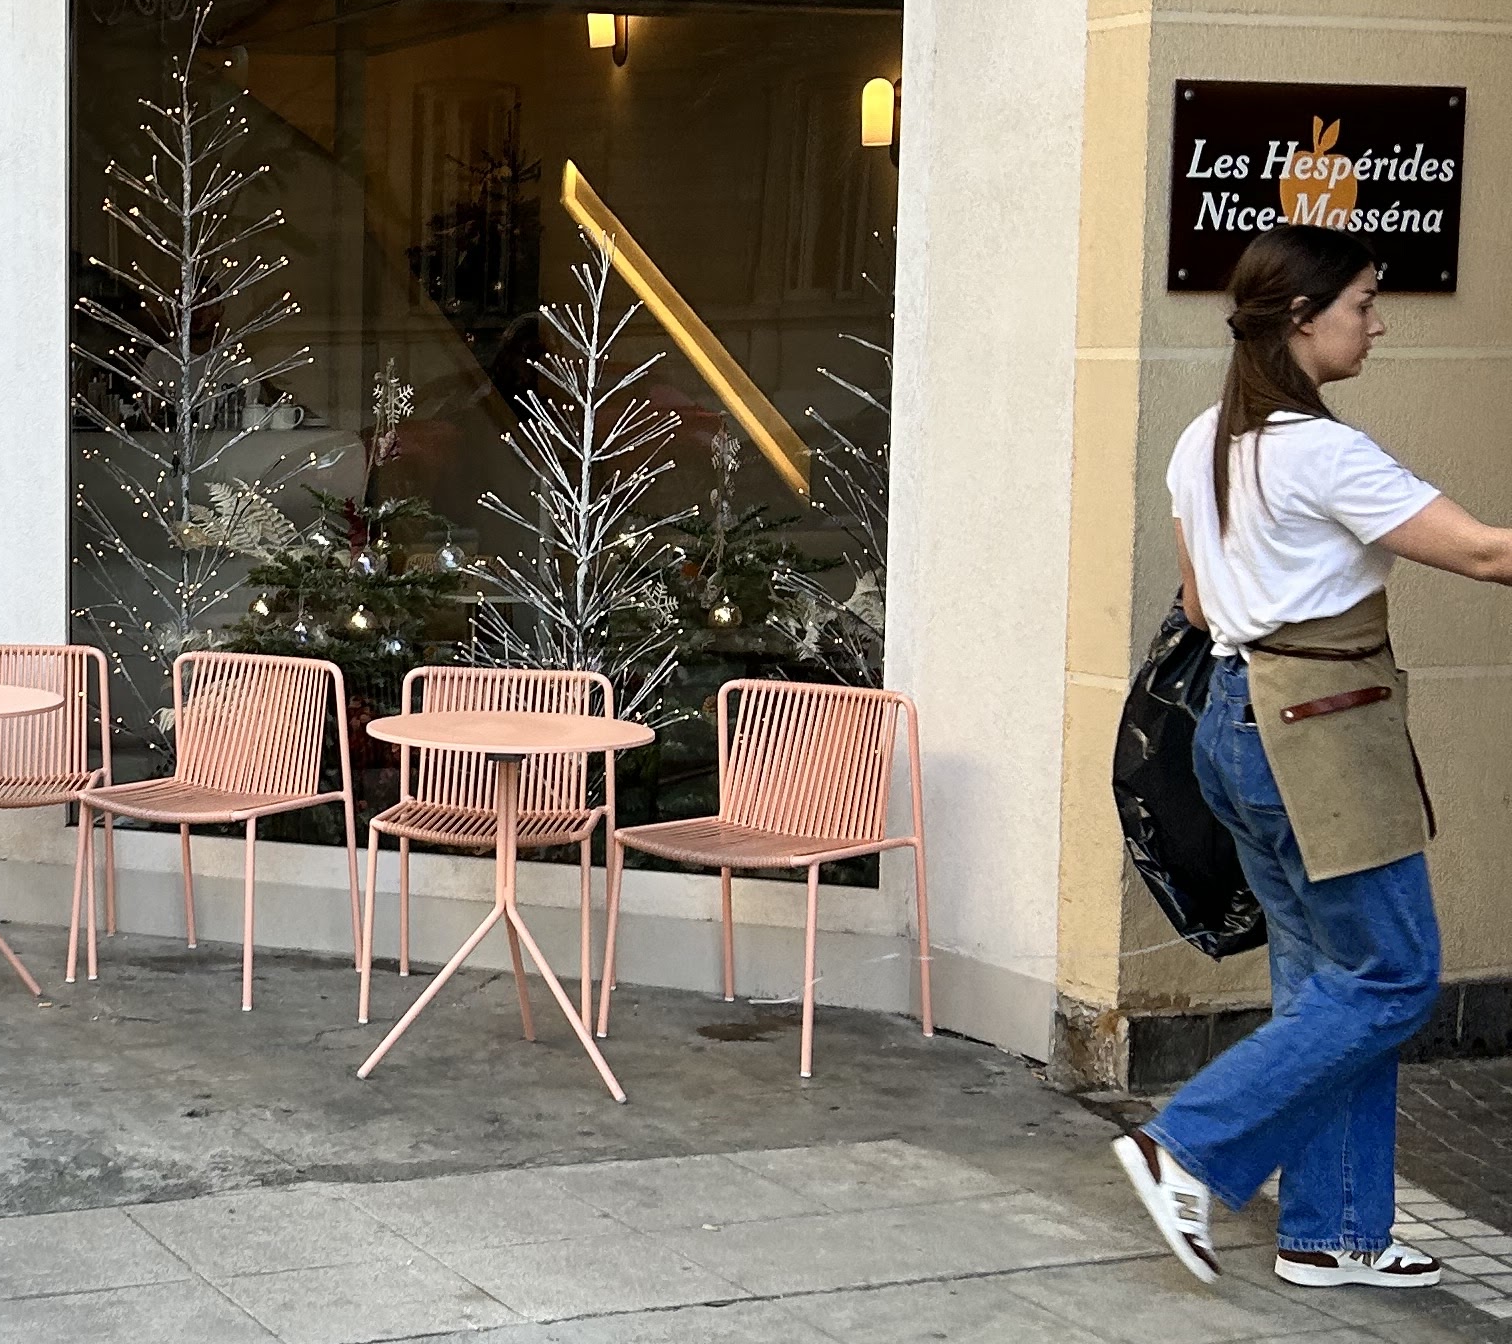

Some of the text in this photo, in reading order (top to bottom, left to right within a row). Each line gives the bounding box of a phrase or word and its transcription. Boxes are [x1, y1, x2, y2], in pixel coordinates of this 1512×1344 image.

[1186, 139, 1456, 189] Les Hespérides
[1194, 191, 1444, 234] Nice-Masséna
